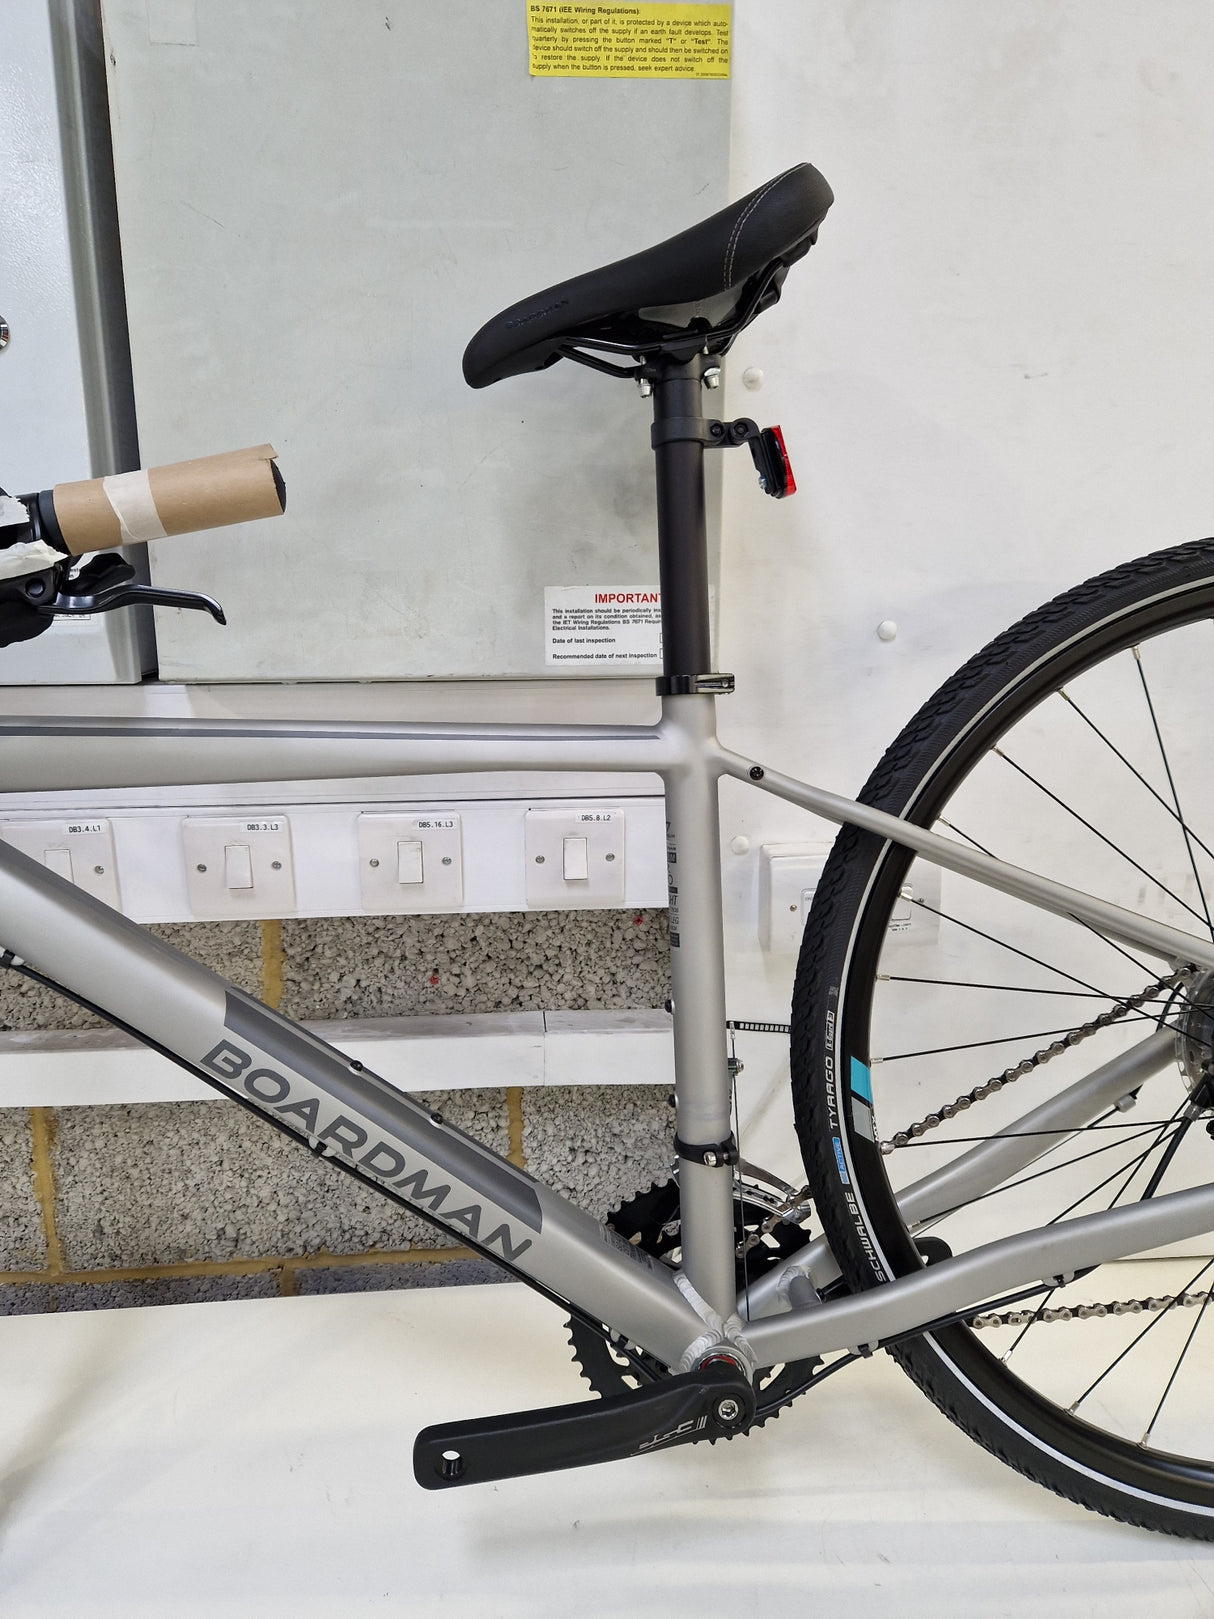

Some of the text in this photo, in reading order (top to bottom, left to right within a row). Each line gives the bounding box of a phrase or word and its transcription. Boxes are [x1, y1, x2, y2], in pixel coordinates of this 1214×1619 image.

[594, 592, 661, 604] IMPORTAN
[826, 1056, 838, 1129] TYRAGO
[200, 1039, 533, 1262] BOARDMAN
[845, 1192, 886, 1282] SCHWALBE
